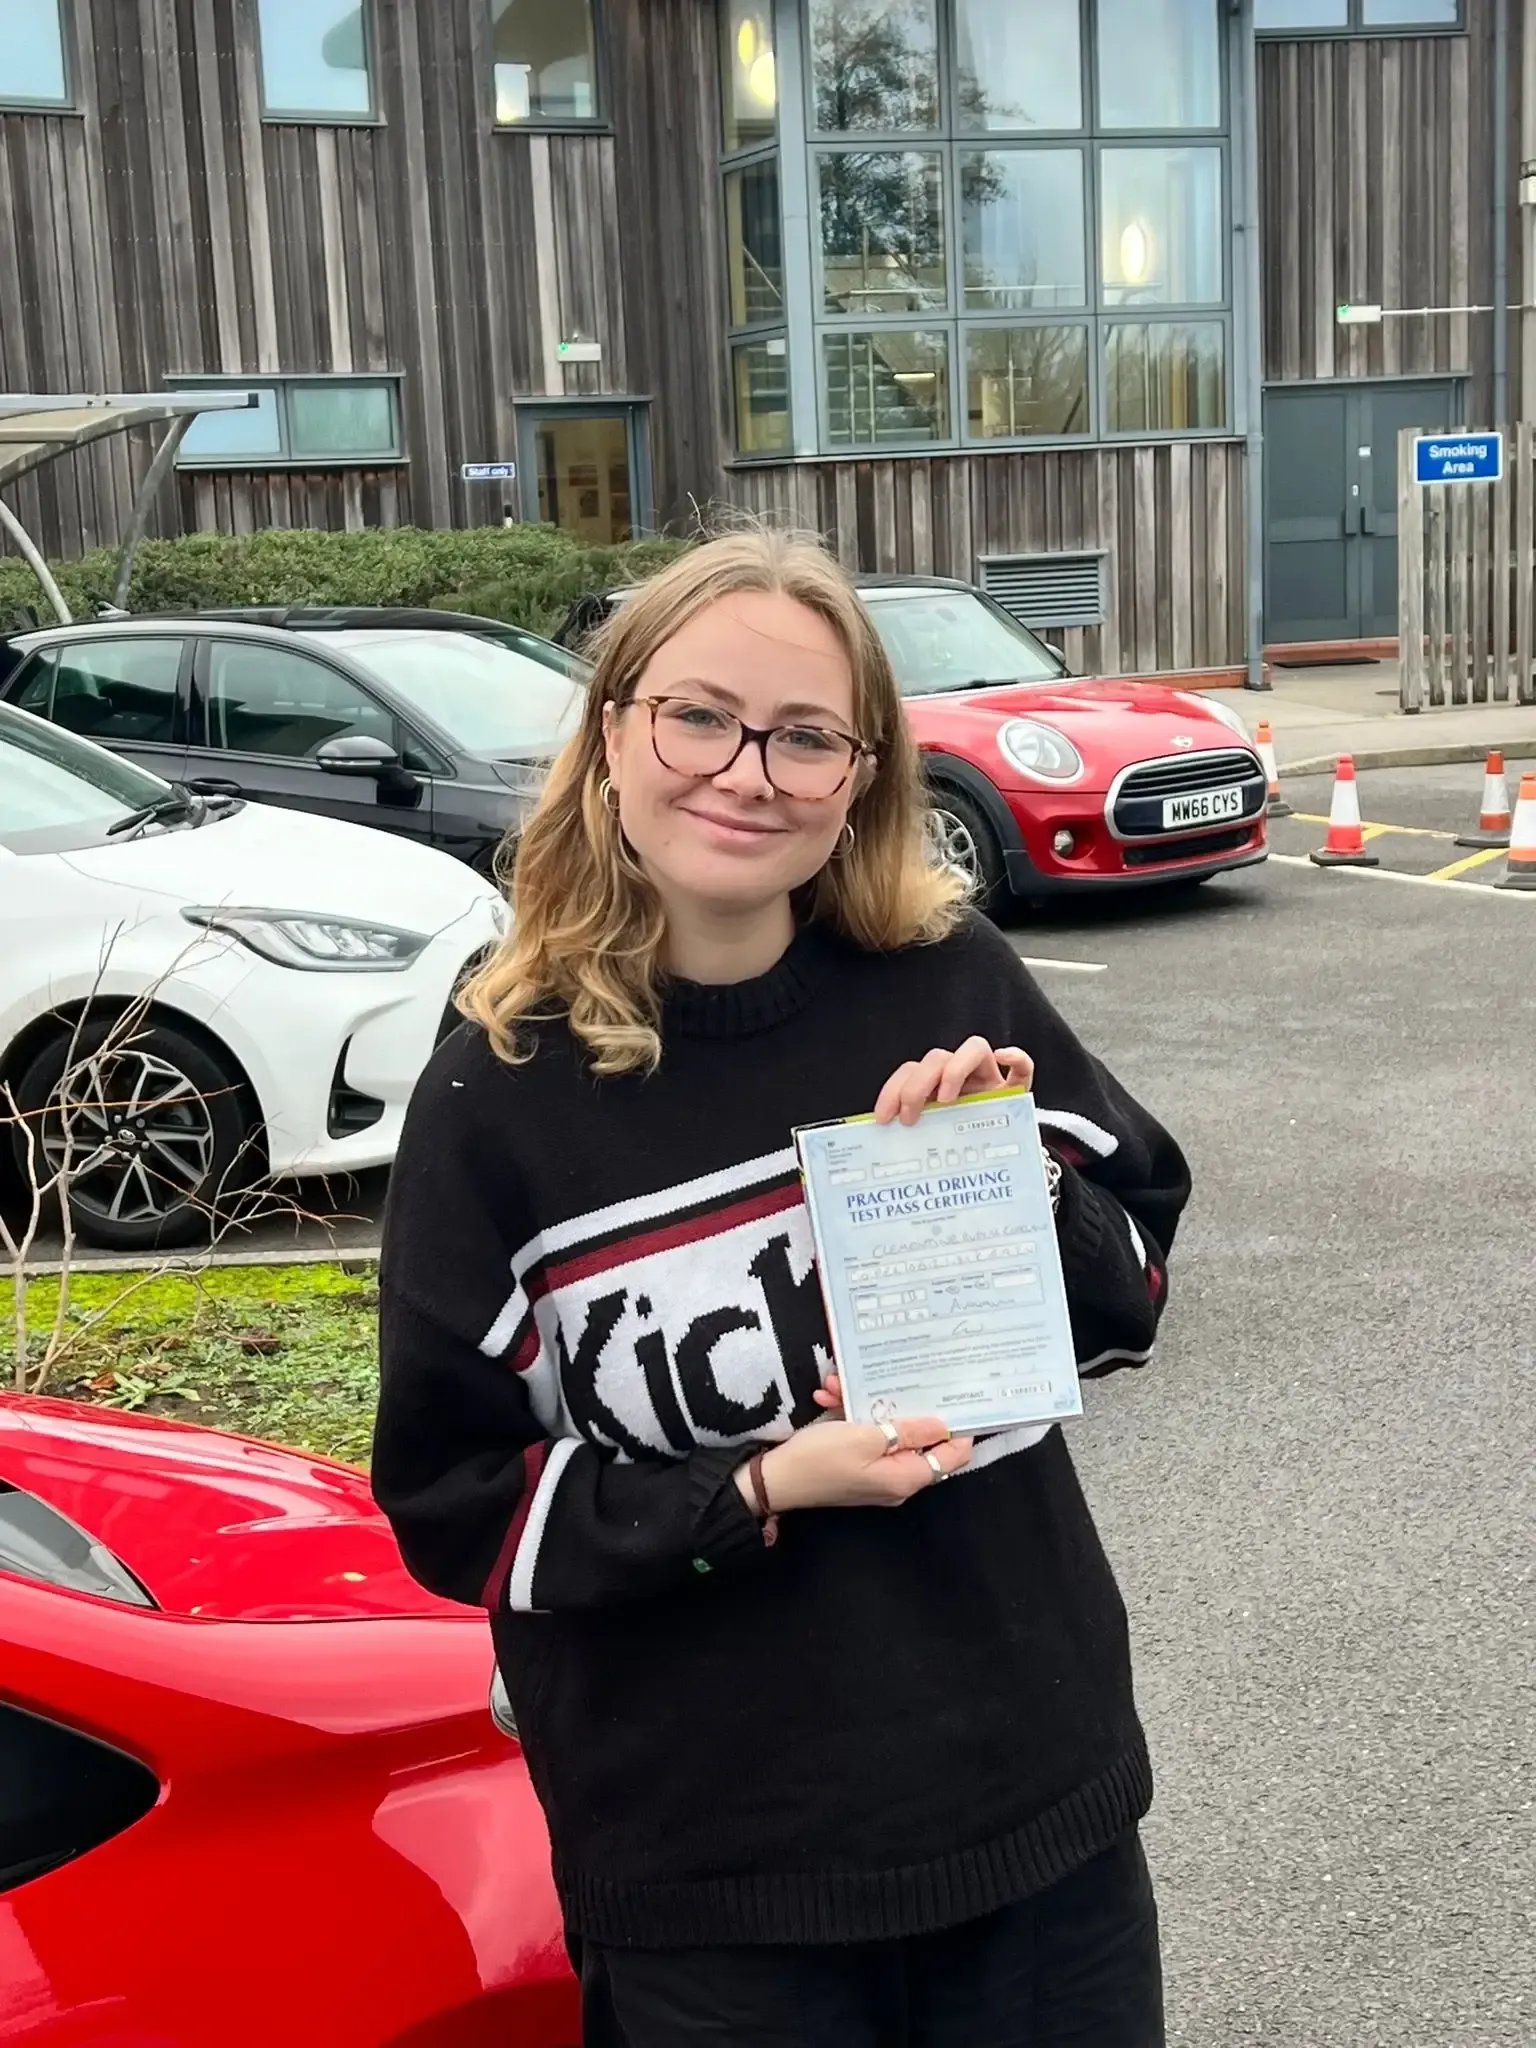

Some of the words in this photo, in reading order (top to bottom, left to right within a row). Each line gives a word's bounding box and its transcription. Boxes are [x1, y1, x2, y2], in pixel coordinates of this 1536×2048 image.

[1428, 443, 1487, 459] Smoking
[1442, 461, 1475, 475] Area
[1172, 798, 1209, 822] MW66
[1213, 792, 1238, 815] CYS
[846, 1182, 933, 1209] PRACTICAL
[938, 1169, 1011, 1194] DRIVING
[850, 1207, 881, 1224] TEST
[886, 1200, 921, 1217] PASS
[924, 1185, 1013, 1210] CERTIFICATE
